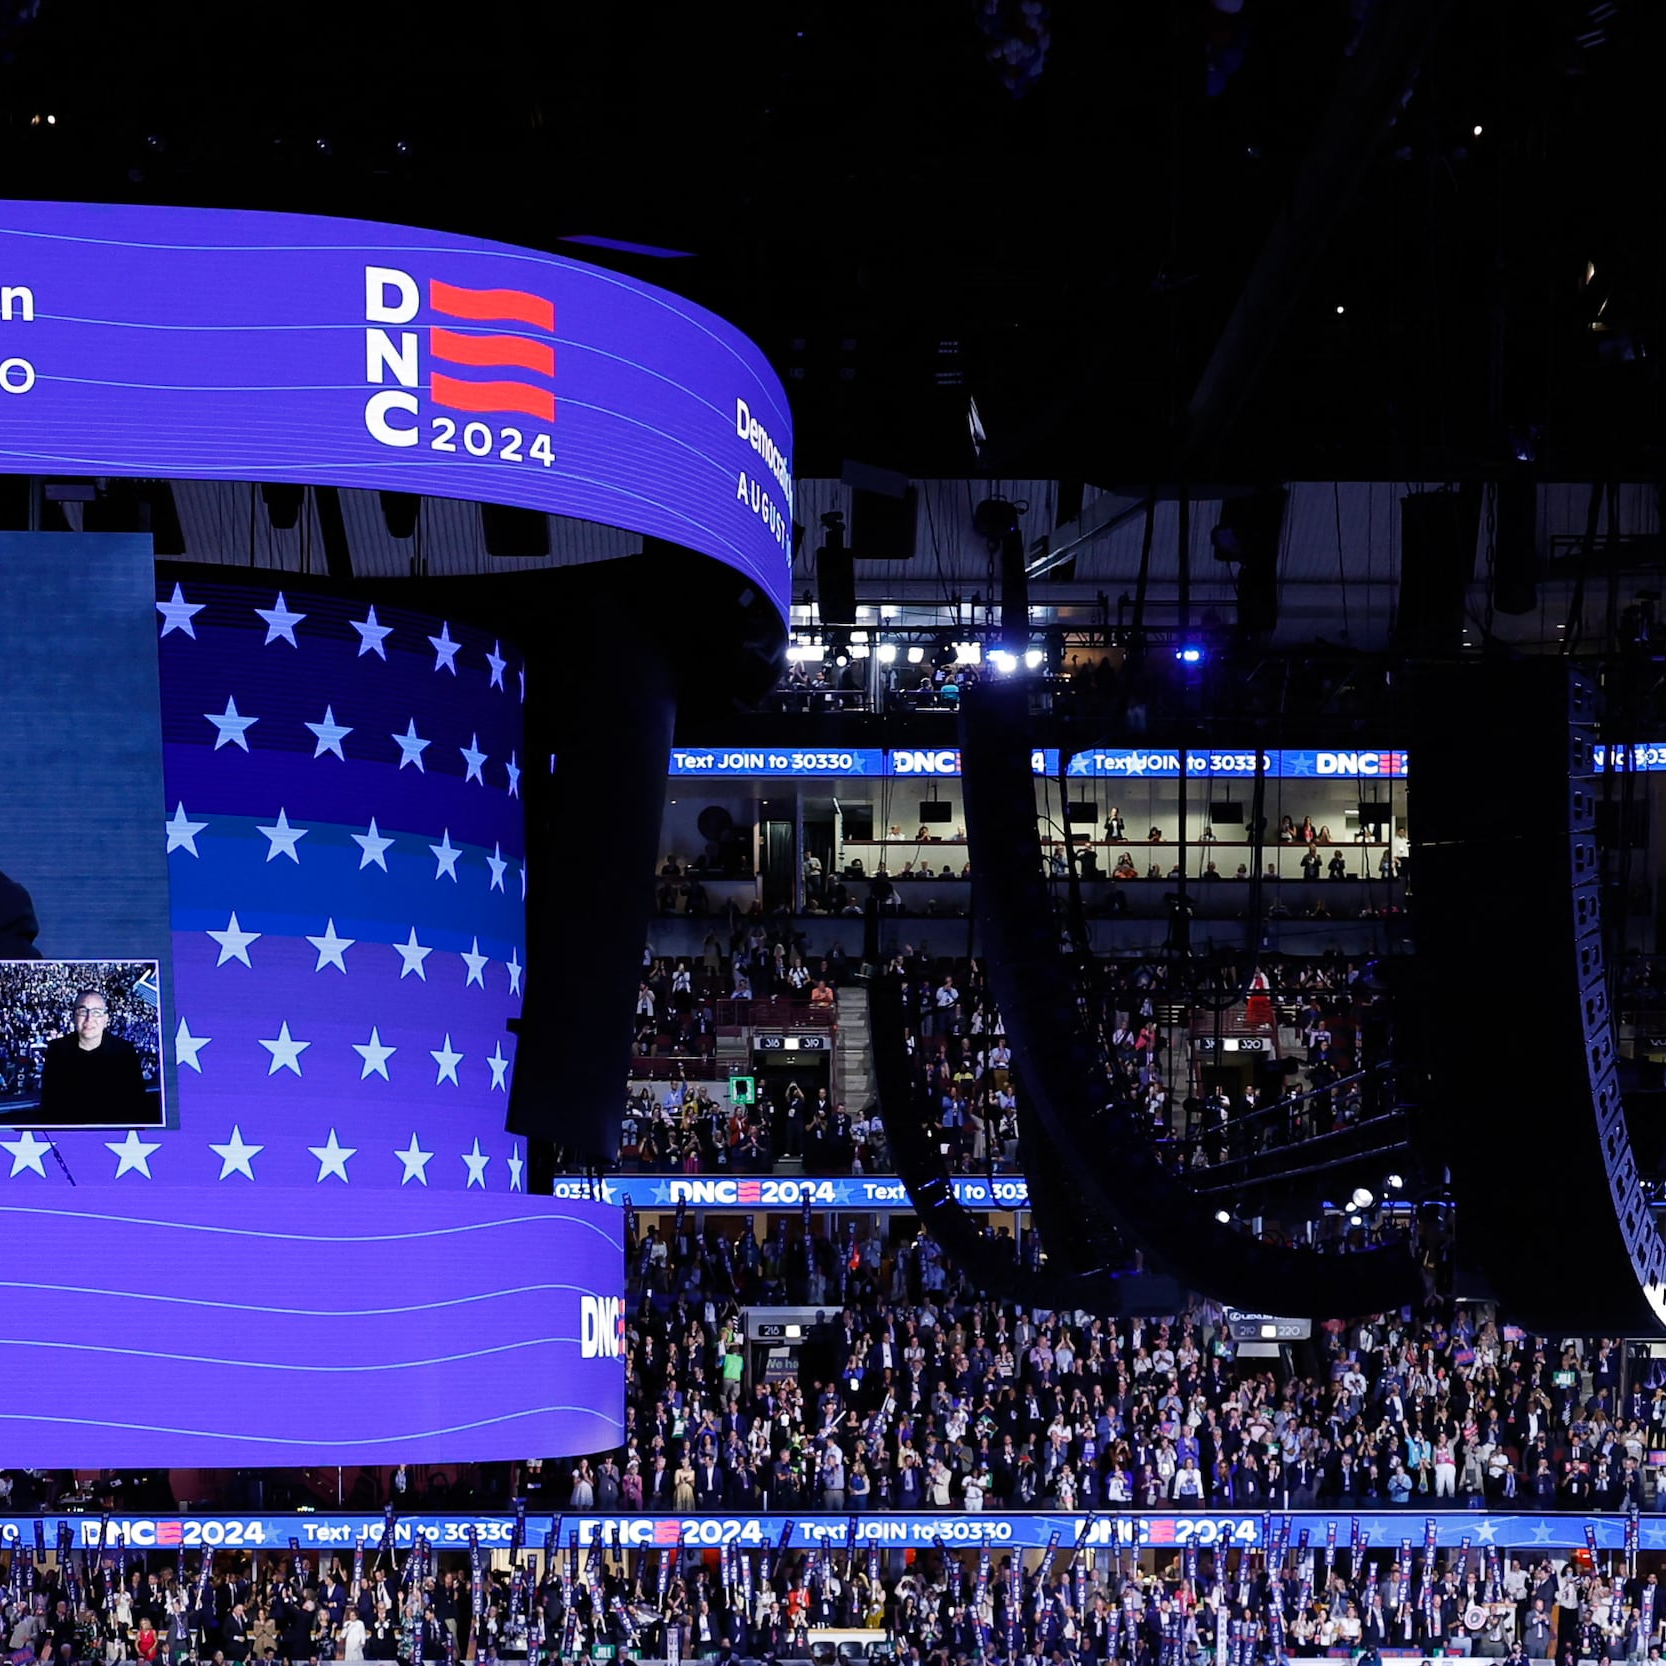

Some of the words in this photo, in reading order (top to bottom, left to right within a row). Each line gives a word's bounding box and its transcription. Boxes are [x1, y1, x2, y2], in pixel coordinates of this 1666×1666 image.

[431, 419, 556, 468] 2024
[736, 471, 785, 548] AUGUST
[673, 753, 714, 770] Text
[717, 753, 765, 769] JOIN
[768, 753, 786, 768] to
[789, 753, 852, 769] 30330
[895, 751, 954, 772] DNC
[1095, 754, 1135, 771] Text
[1136, 754, 1180, 769] JOIN
[1187, 754, 1205, 770] to
[1317, 752, 1378, 773] DNC
[765, 1039, 780, 1049] 318
[804, 1039, 819, 1049] 319
[1240, 1040, 1261, 1050] 320
[671, 1181, 737, 1202] DNC
[863, 1183, 905, 1200] Text
[183, 1520, 265, 1545] 2024
[303, 1522, 349, 1541] Text
[680, 1520, 763, 1544] 2024
[800, 1521, 848, 1541] Text
[913, 1522, 934, 1541] to
[940, 1522, 1012, 1541] 30330
